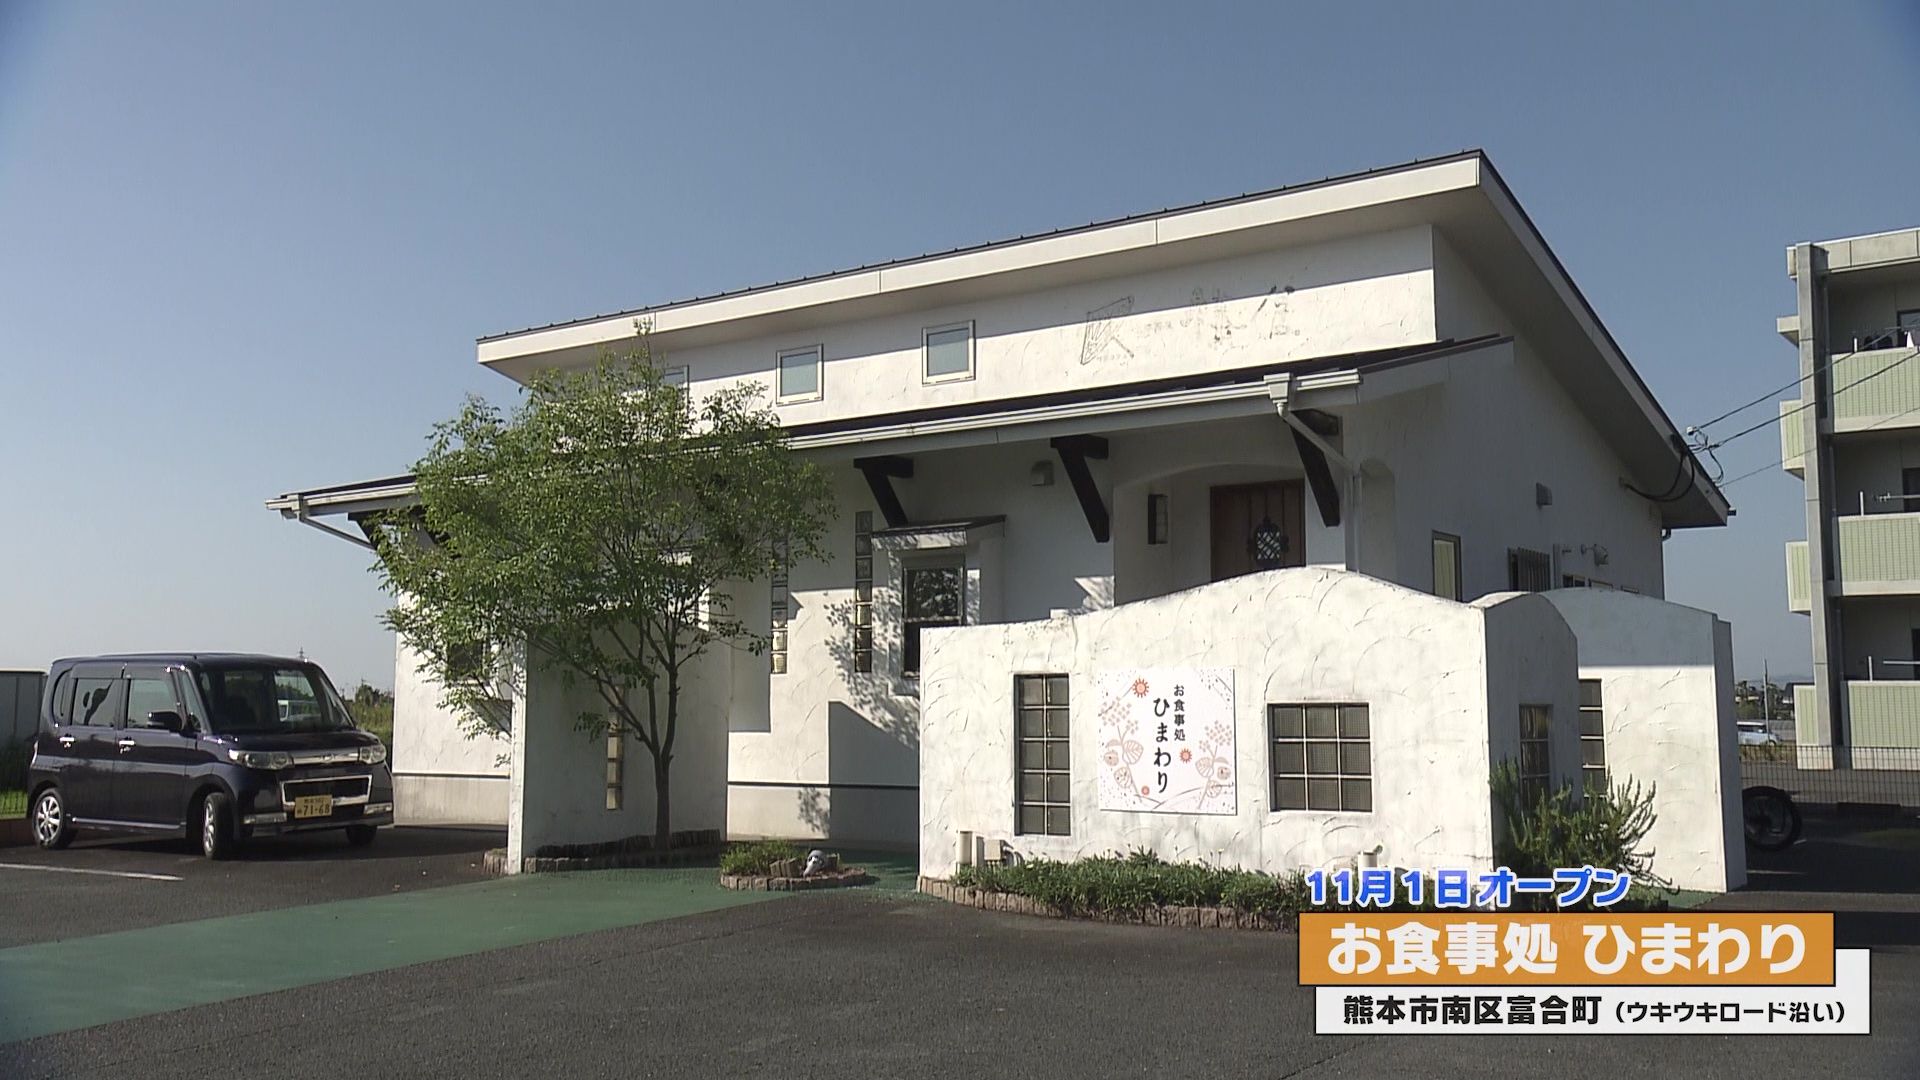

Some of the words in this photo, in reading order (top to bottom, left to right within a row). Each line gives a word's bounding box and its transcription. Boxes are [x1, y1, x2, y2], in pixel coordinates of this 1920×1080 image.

[1153, 698, 1171, 793] ひまわり
[1174, 684, 1186, 741] お食事処
